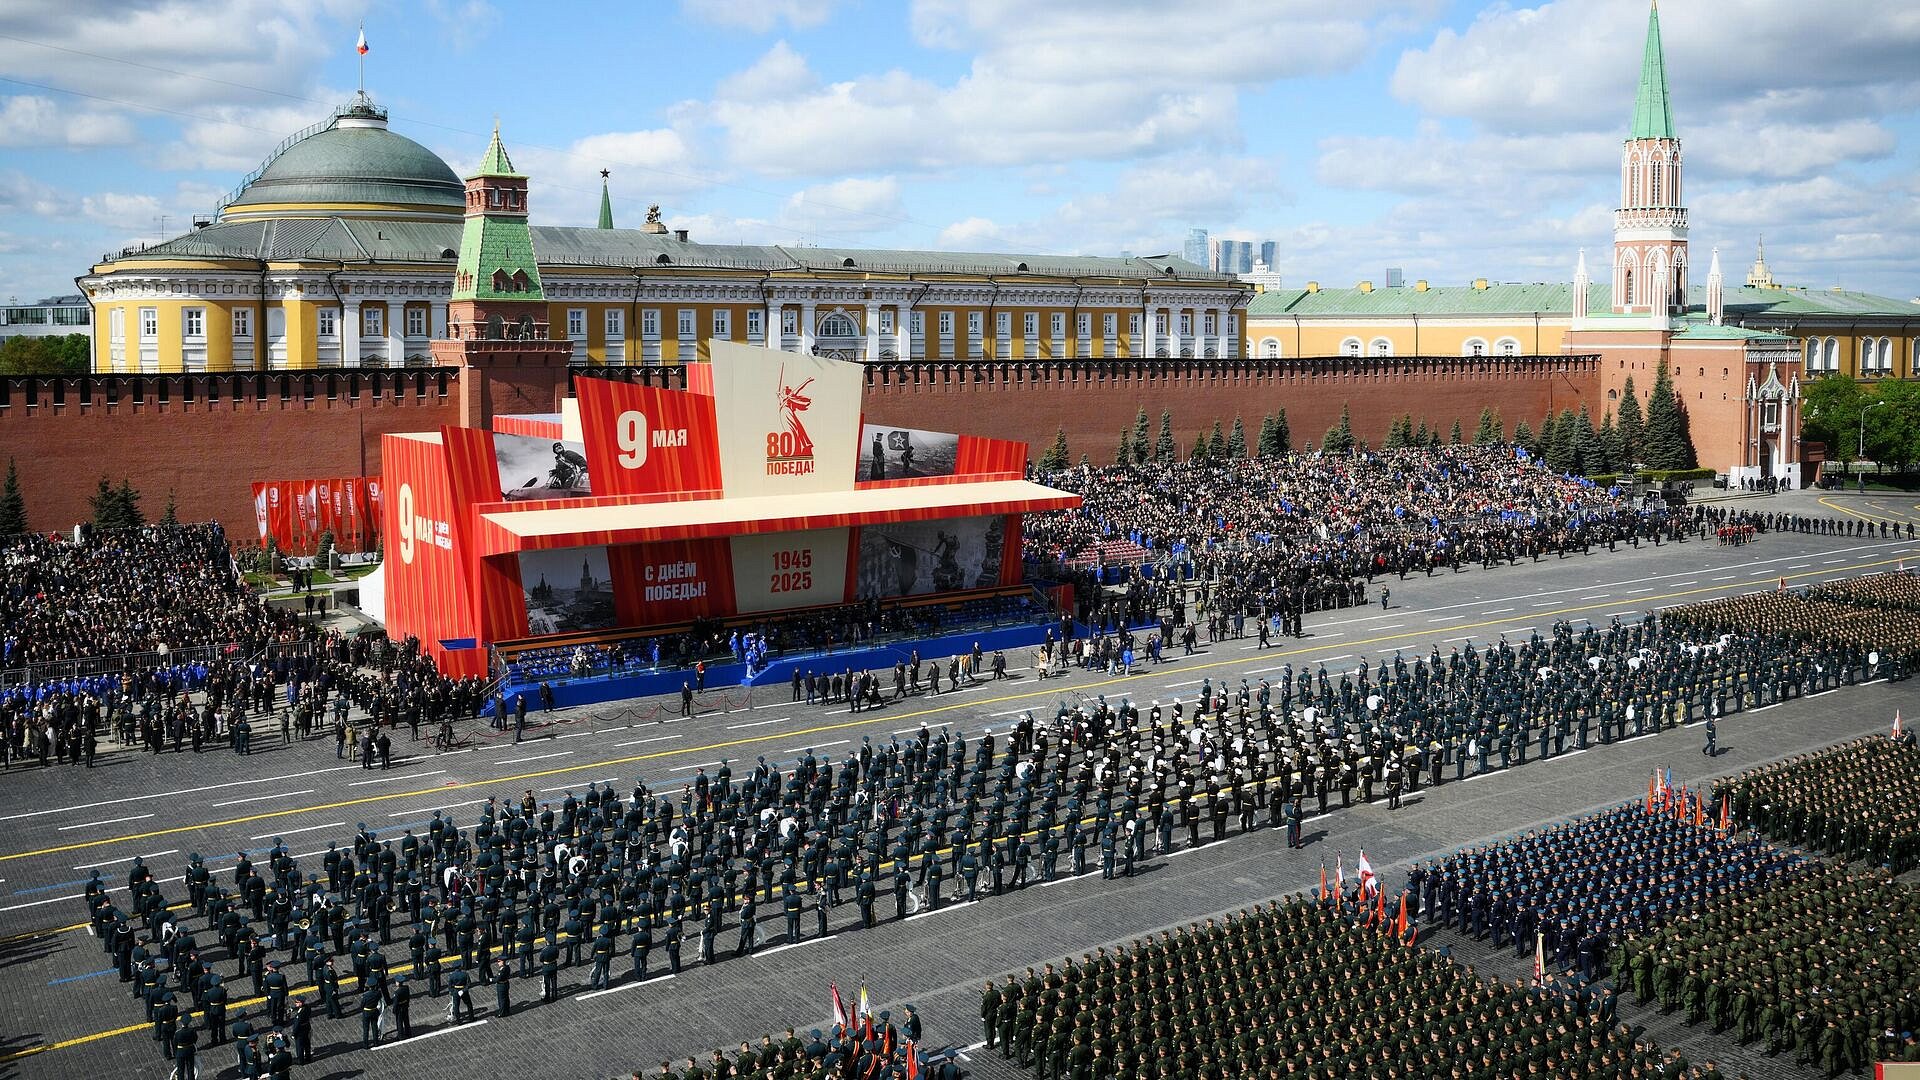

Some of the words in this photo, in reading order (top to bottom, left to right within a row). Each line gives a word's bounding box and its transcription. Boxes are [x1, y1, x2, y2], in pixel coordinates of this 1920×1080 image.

[616, 410, 648, 470] 9
[652, 428, 688, 448] МАЯ
[766, 431, 794, 458] 80
[766, 460, 815, 476] ПОБЕДА!
[399, 483, 414, 565] 9
[415, 515, 434, 545] МАЯ
[772, 549, 812, 570] 1945
[645, 565, 654, 582] С
[657, 561, 697, 582] ДНЁМ
[770, 571, 812, 593] 2025
[645, 582, 707, 602] ПОБЕДЫ!
